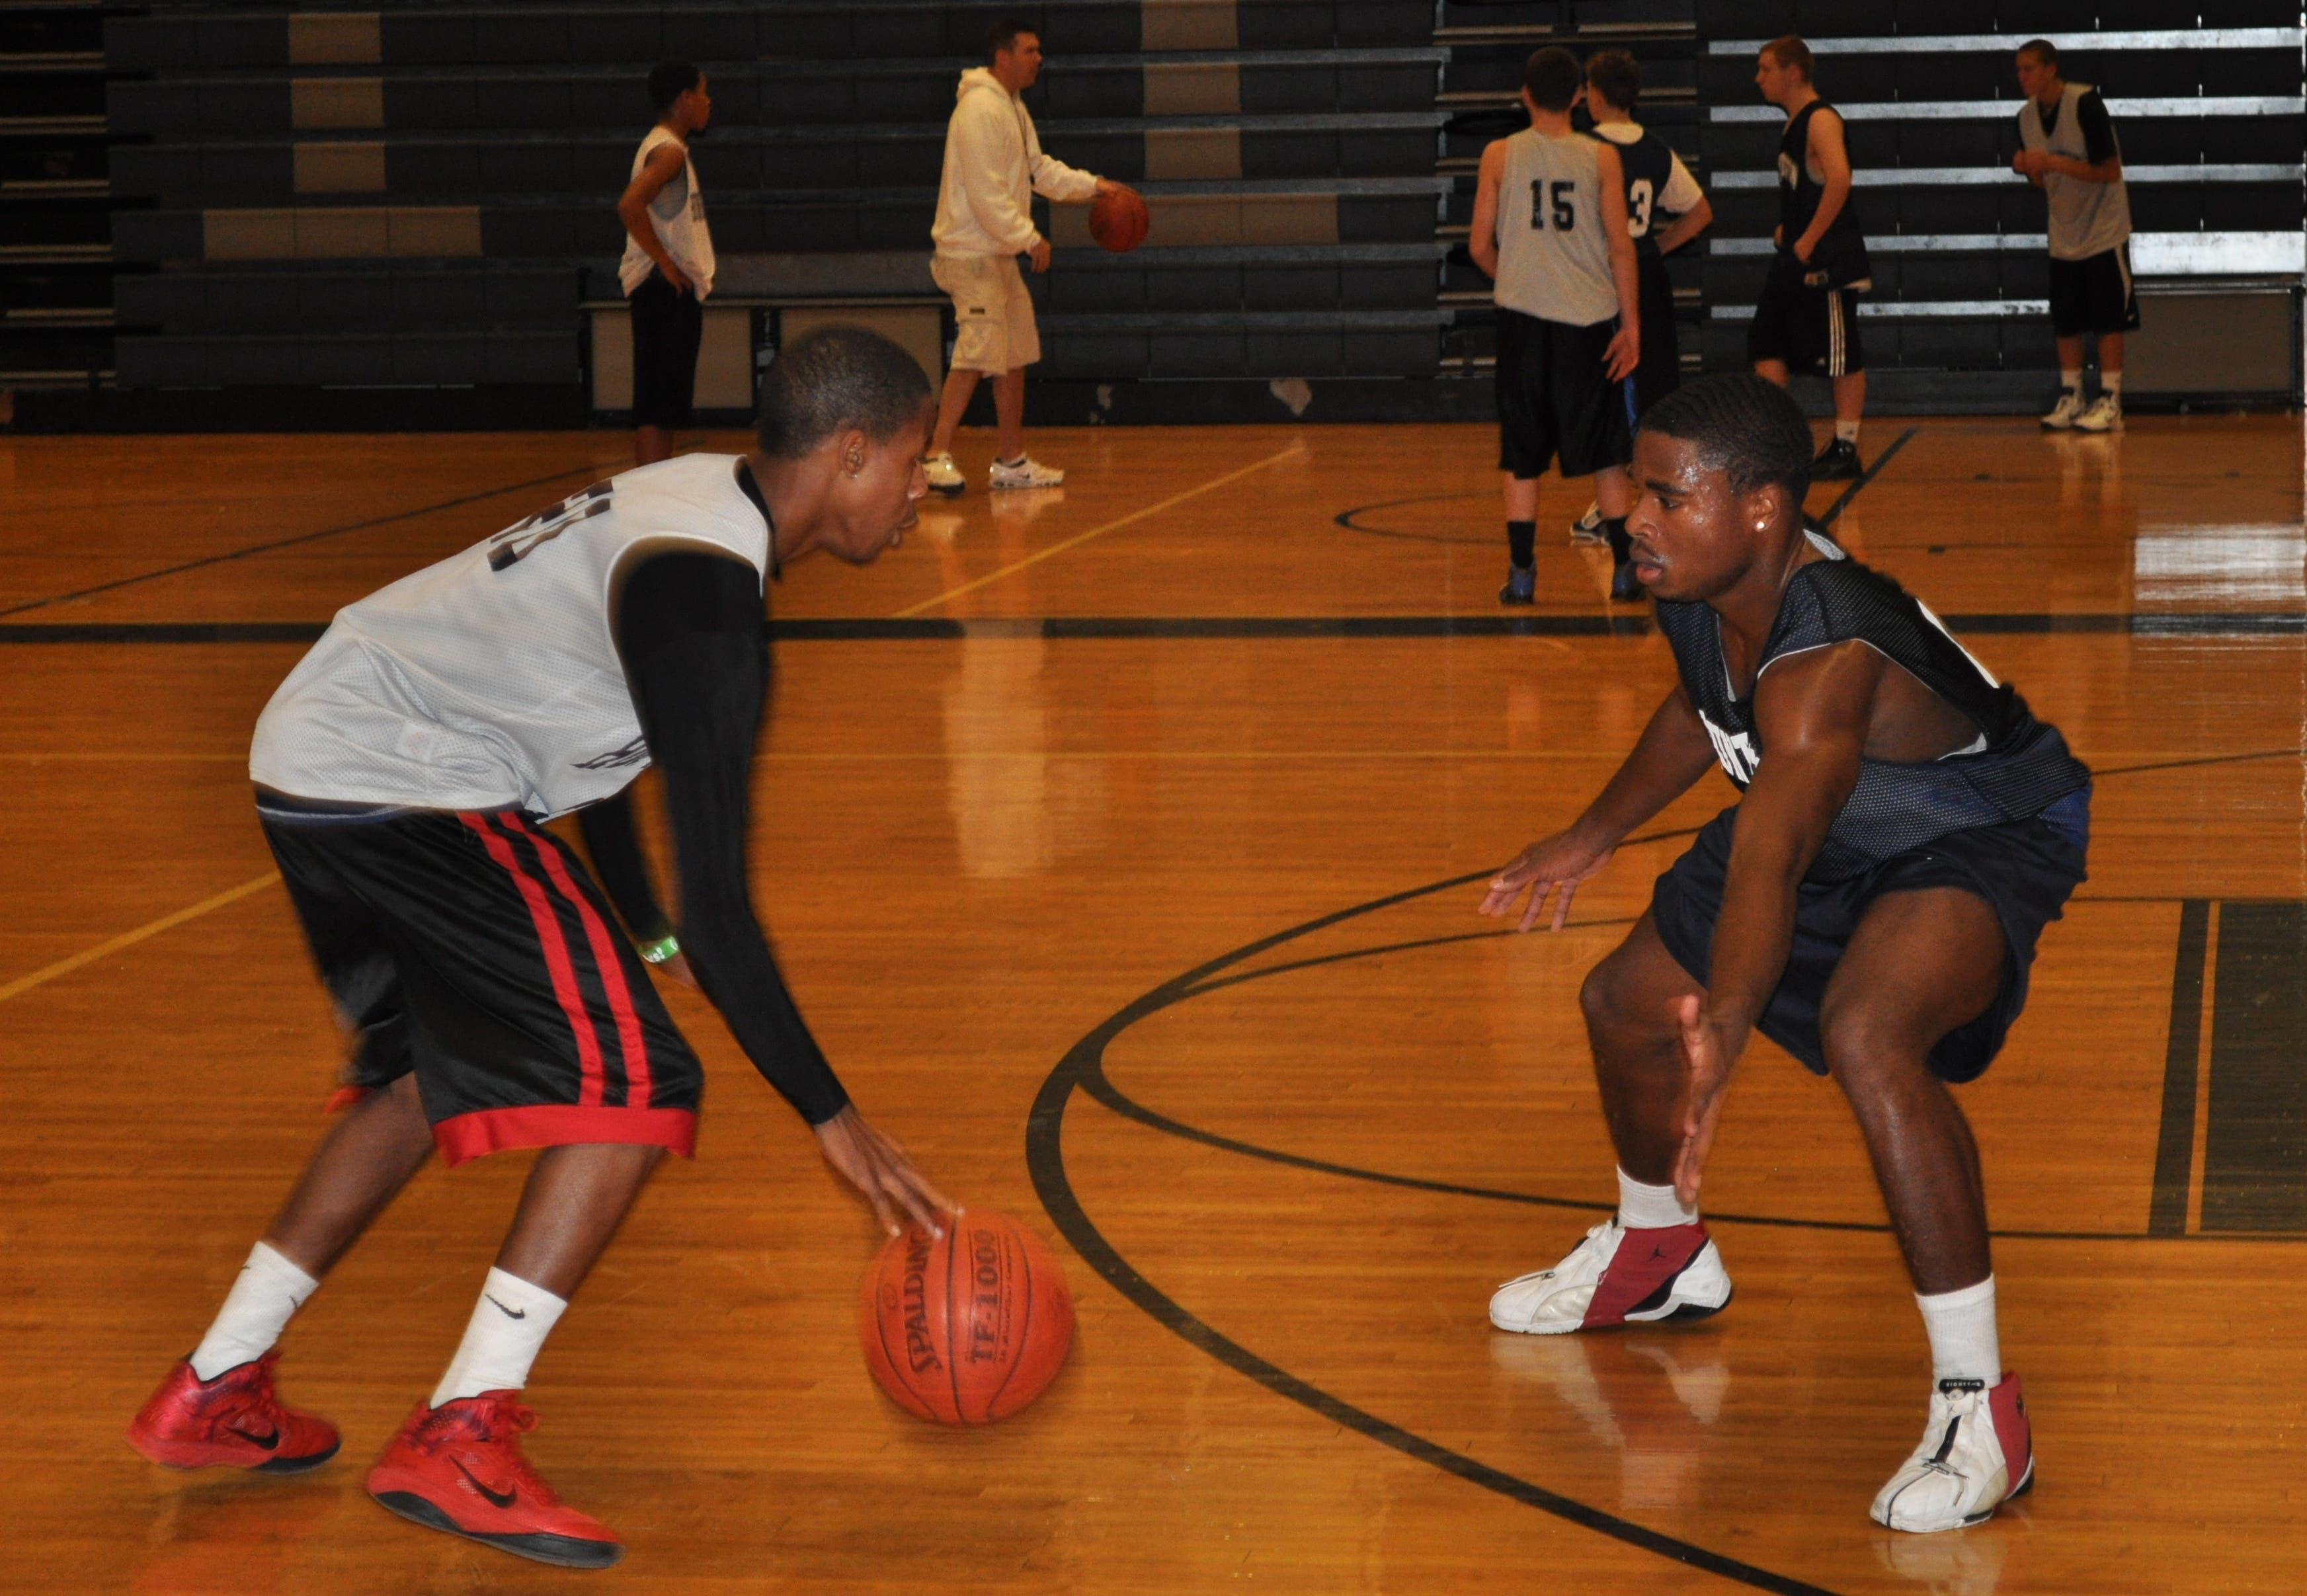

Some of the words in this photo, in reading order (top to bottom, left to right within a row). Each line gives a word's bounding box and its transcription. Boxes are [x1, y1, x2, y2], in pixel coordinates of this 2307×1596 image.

[1530, 179, 1574, 231] 15
[1627, 178, 1653, 239] 3
[969, 1228, 999, 1364] TF-1000
